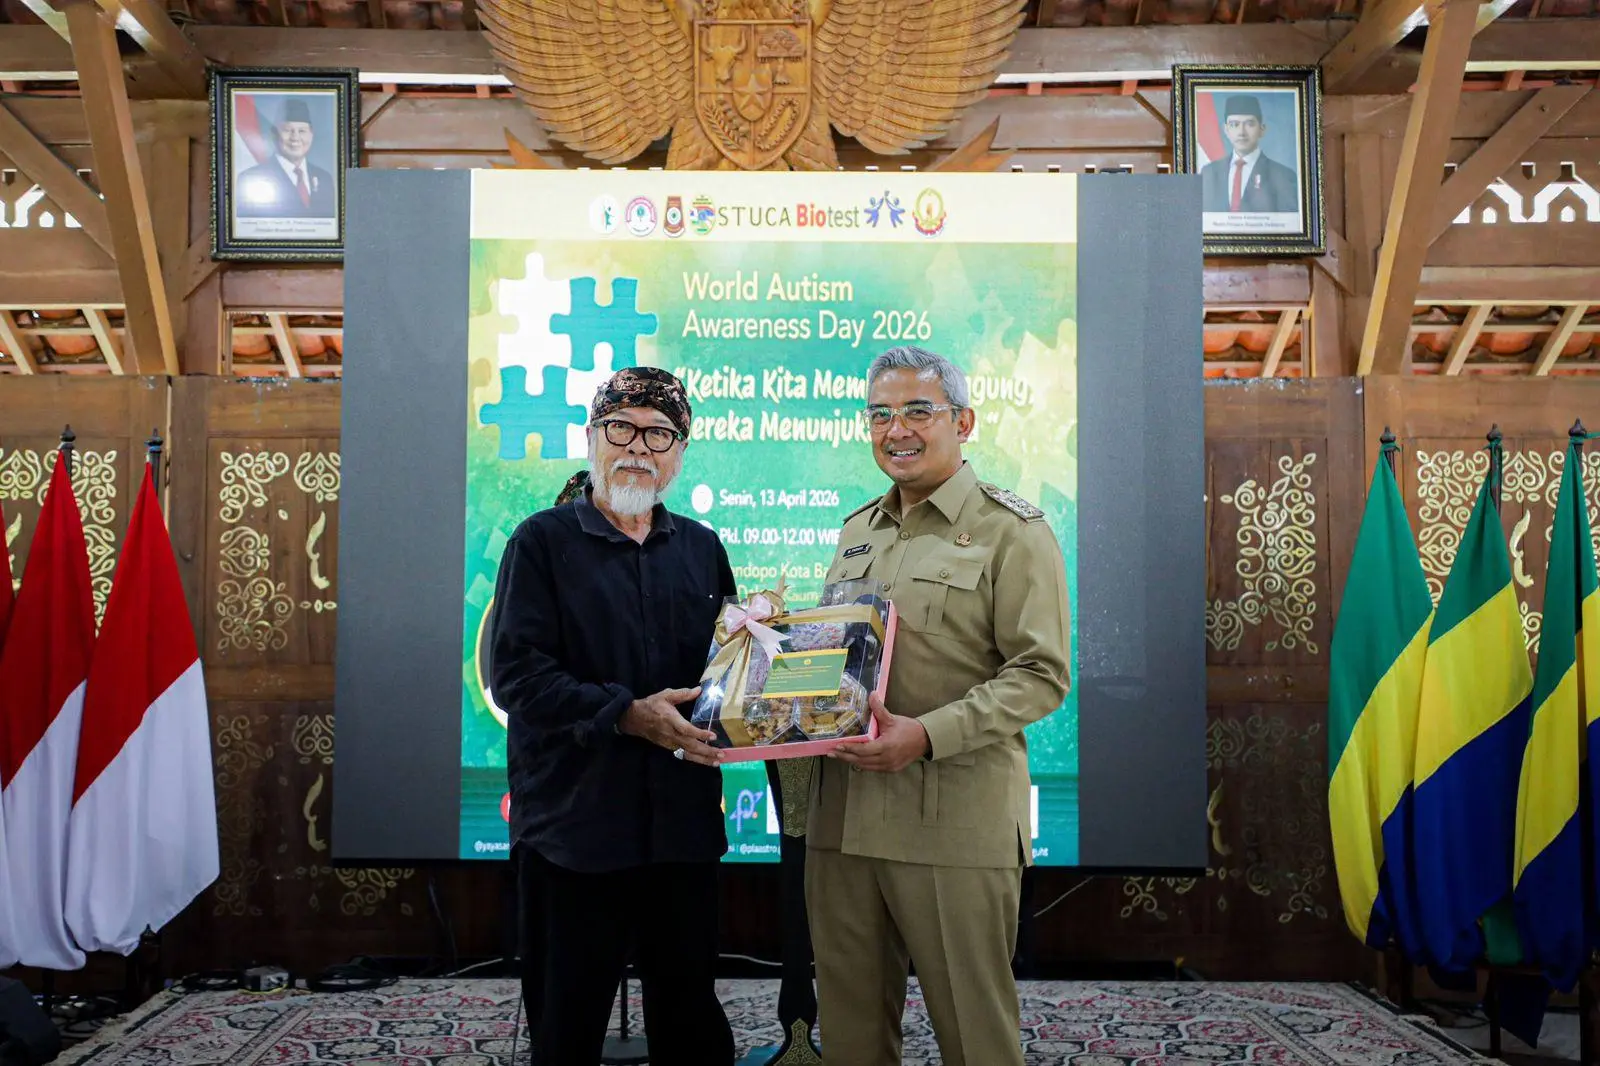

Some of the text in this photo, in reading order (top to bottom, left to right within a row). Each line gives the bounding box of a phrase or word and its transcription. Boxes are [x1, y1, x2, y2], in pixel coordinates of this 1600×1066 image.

[718, 203, 860, 228] STUCA Biotest
[682, 270, 854, 301] World Autism
[682, 308, 932, 348] Awareness Day 2026
[762, 365, 807, 403] Kita
[812, 367, 871, 400] Mem
[688, 408, 754, 441] ereka
[719, 488, 840, 509] Senin, 13 April 2026
[743, 527, 814, 546] 09.00-12.00
[731, 562, 777, 582] endopo
[781, 562, 810, 578] Kota
